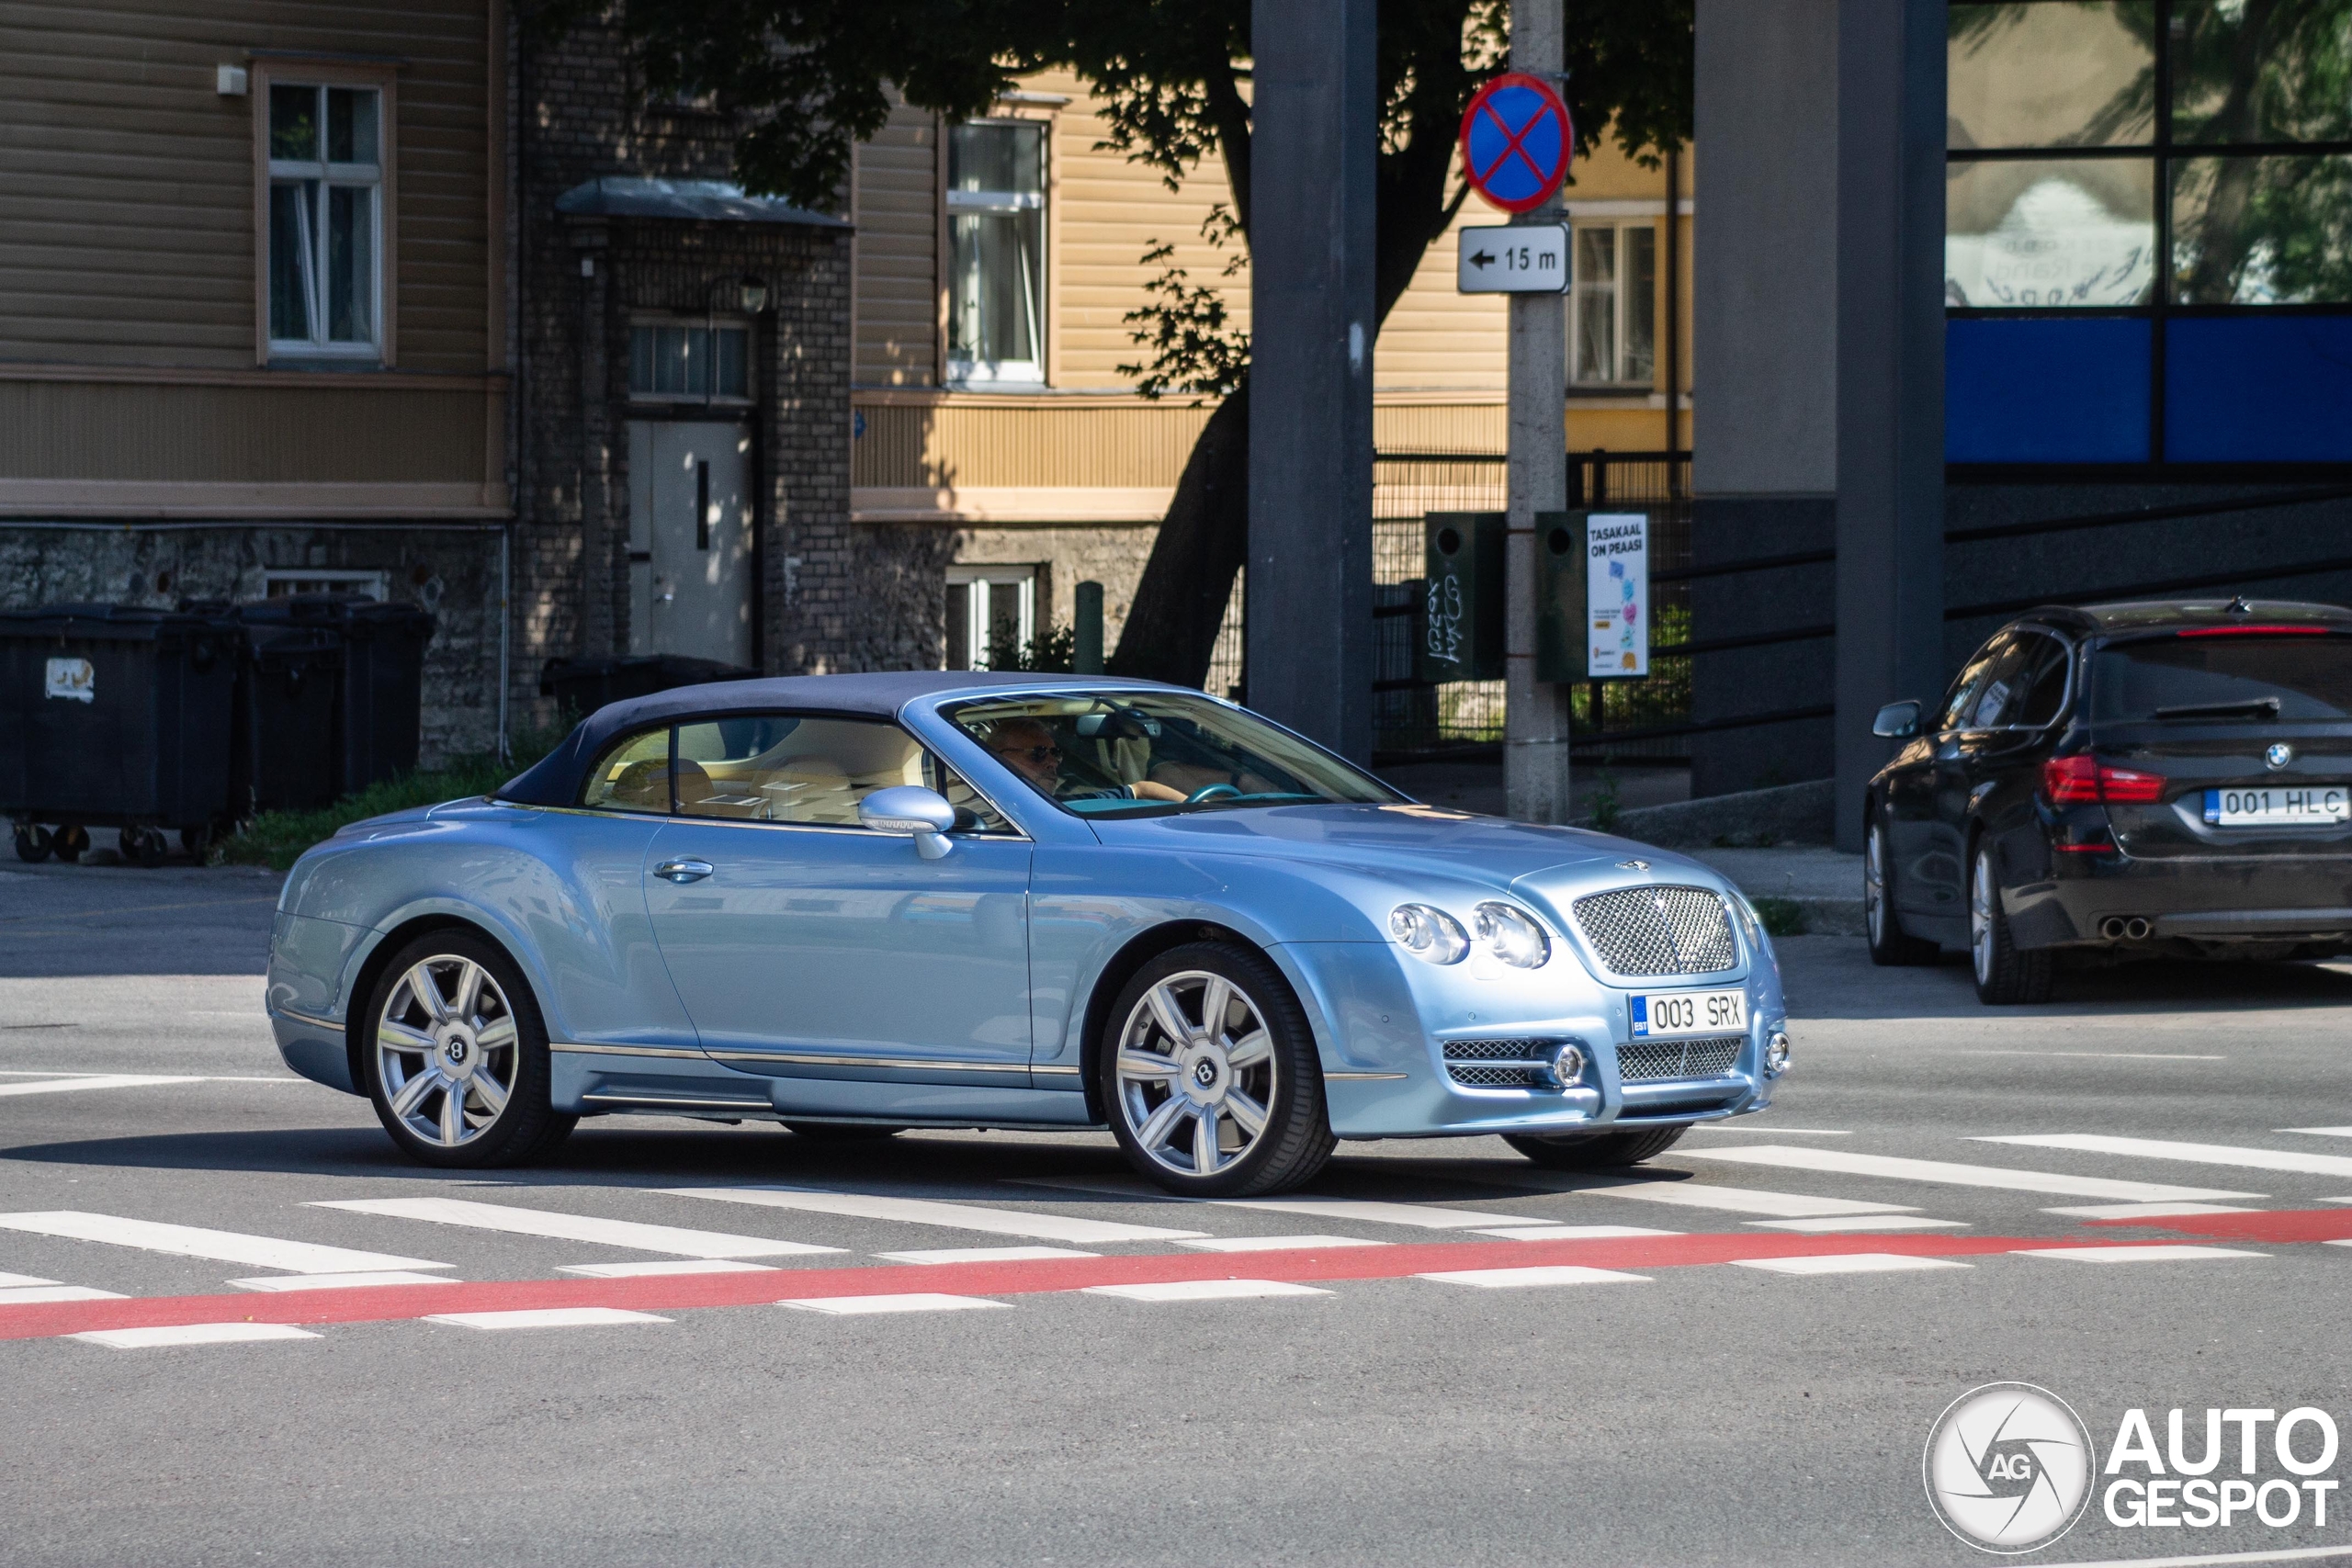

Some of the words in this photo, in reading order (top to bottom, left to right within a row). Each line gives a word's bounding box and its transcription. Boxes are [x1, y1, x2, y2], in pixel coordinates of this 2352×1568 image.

[1506, 247, 1529, 270] 15
[1539, 252, 1555, 270] m
[1590, 524, 1641, 541] TASAKAAL
[1591, 545, 1606, 558] ON
[1609, 539, 1642, 555] PEAASI
[2226, 791, 2269, 815] 001
[2286, 790, 2341, 814] HLC
[1655, 998, 1694, 1029] 003
[1707, 995, 1741, 1026] SRX
[1634, 1021, 1647, 1031] EST
[1197, 1064, 1213, 1083] B
